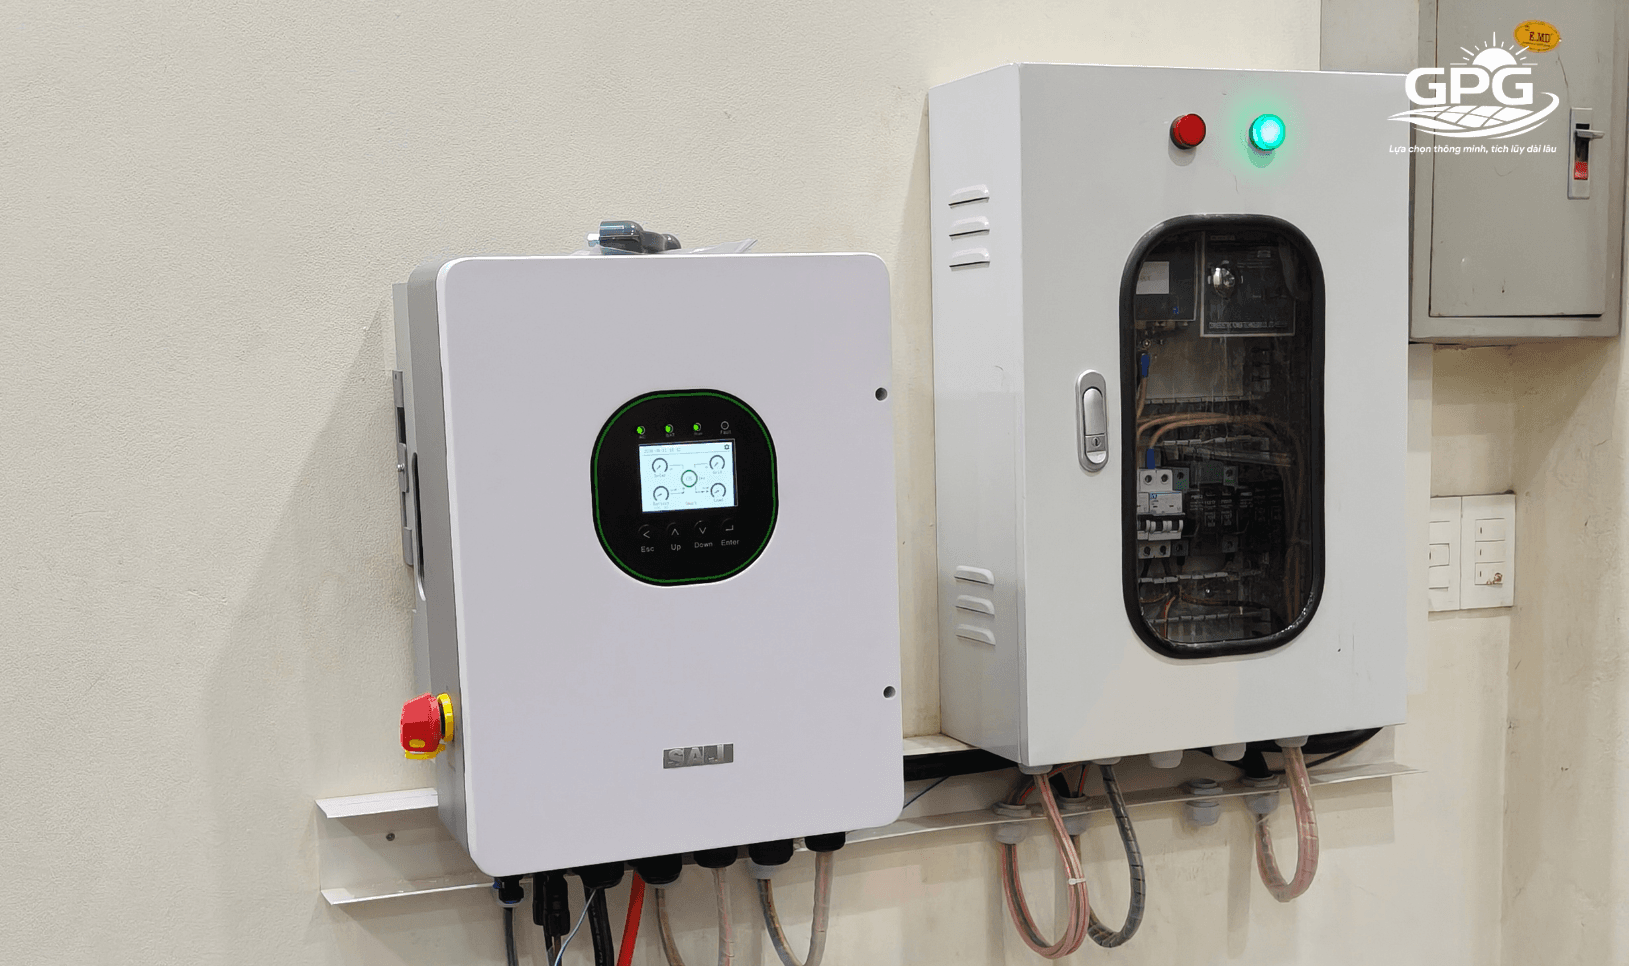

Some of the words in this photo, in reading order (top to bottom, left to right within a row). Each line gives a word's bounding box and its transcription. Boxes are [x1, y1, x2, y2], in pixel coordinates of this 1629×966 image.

[670, 543, 681, 551] Up
[694, 541, 713, 549] Down
[721, 539, 740, 547] Enter
[667, 744, 725, 767] SAJ
